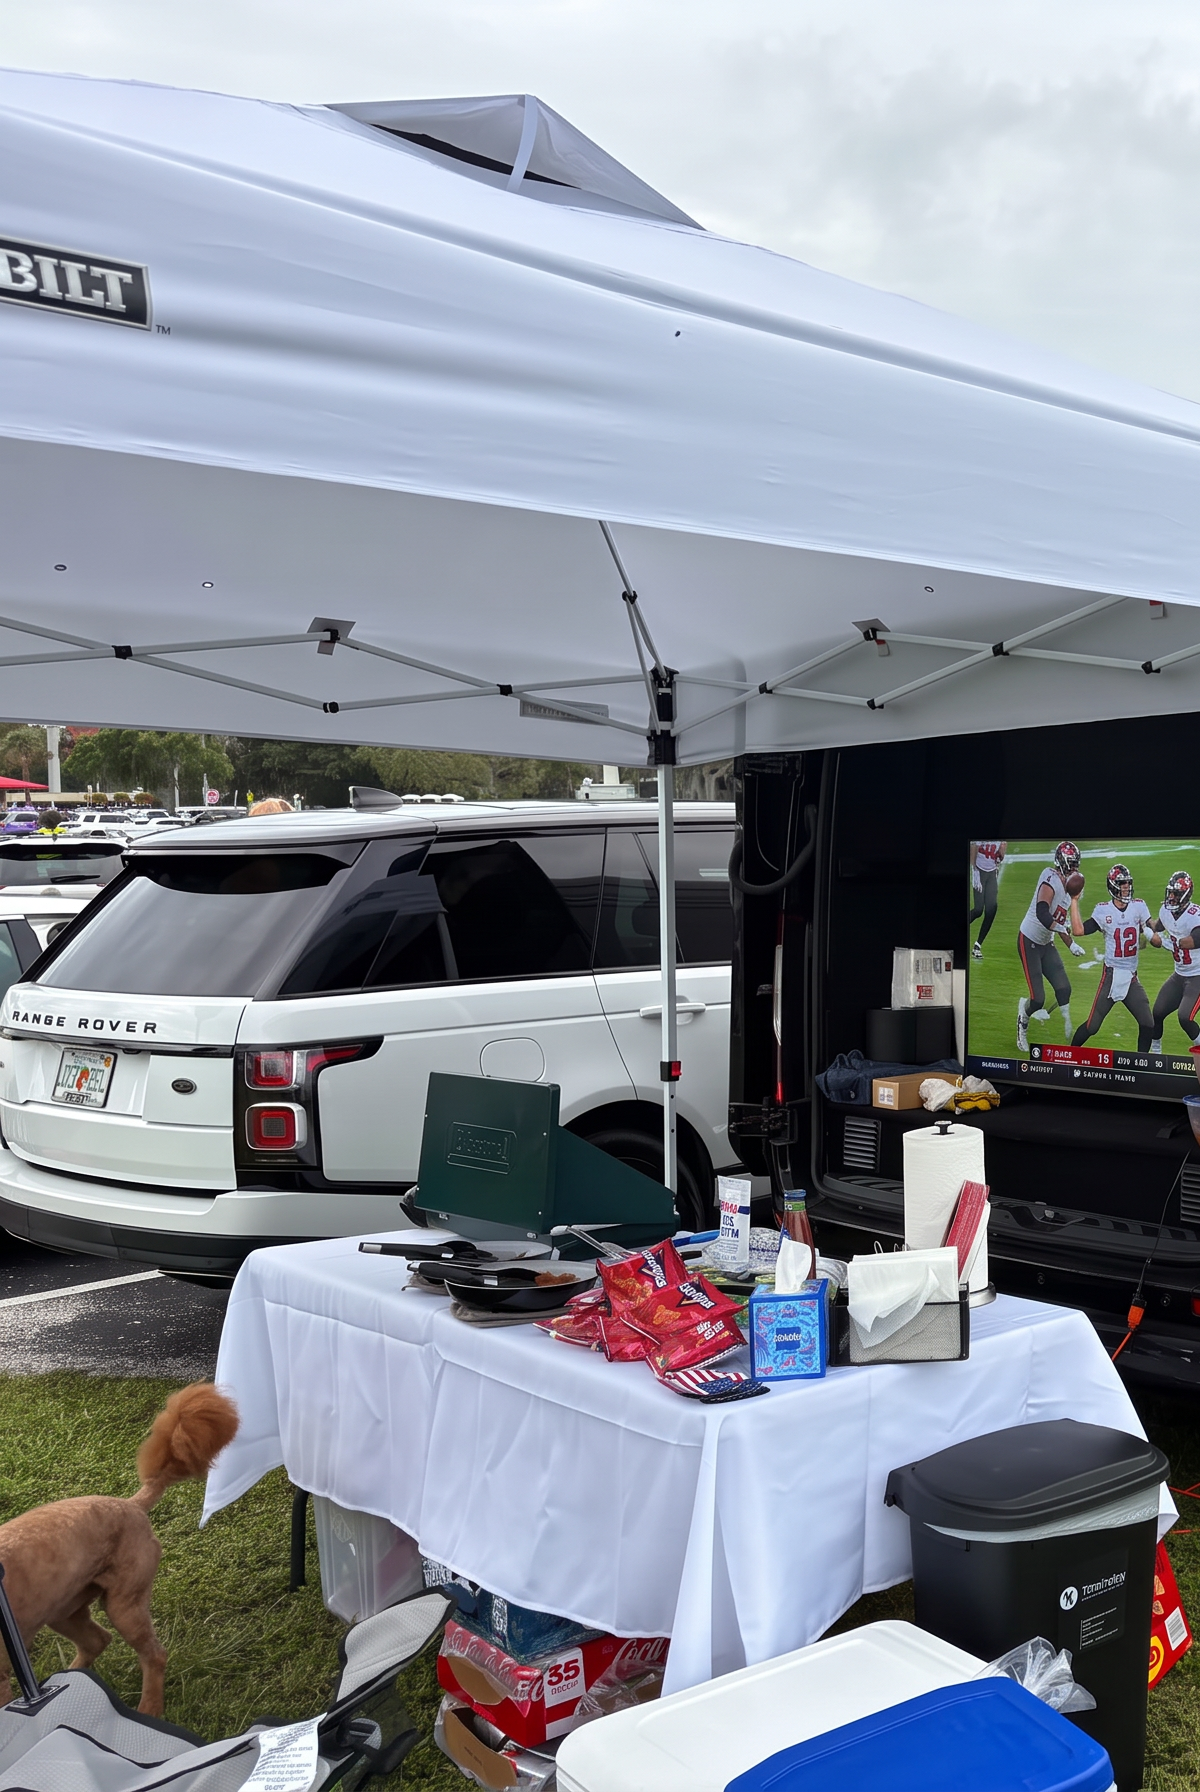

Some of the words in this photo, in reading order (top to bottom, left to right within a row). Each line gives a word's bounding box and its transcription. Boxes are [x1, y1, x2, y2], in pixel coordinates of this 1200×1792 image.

[0, 248, 133, 312] BILT
[1113, 926, 1138, 958] 12
[12, 1011, 66, 1027] RANGE
[78, 1018, 157, 1034] ROVER
[548, 1658, 580, 1687] 35
